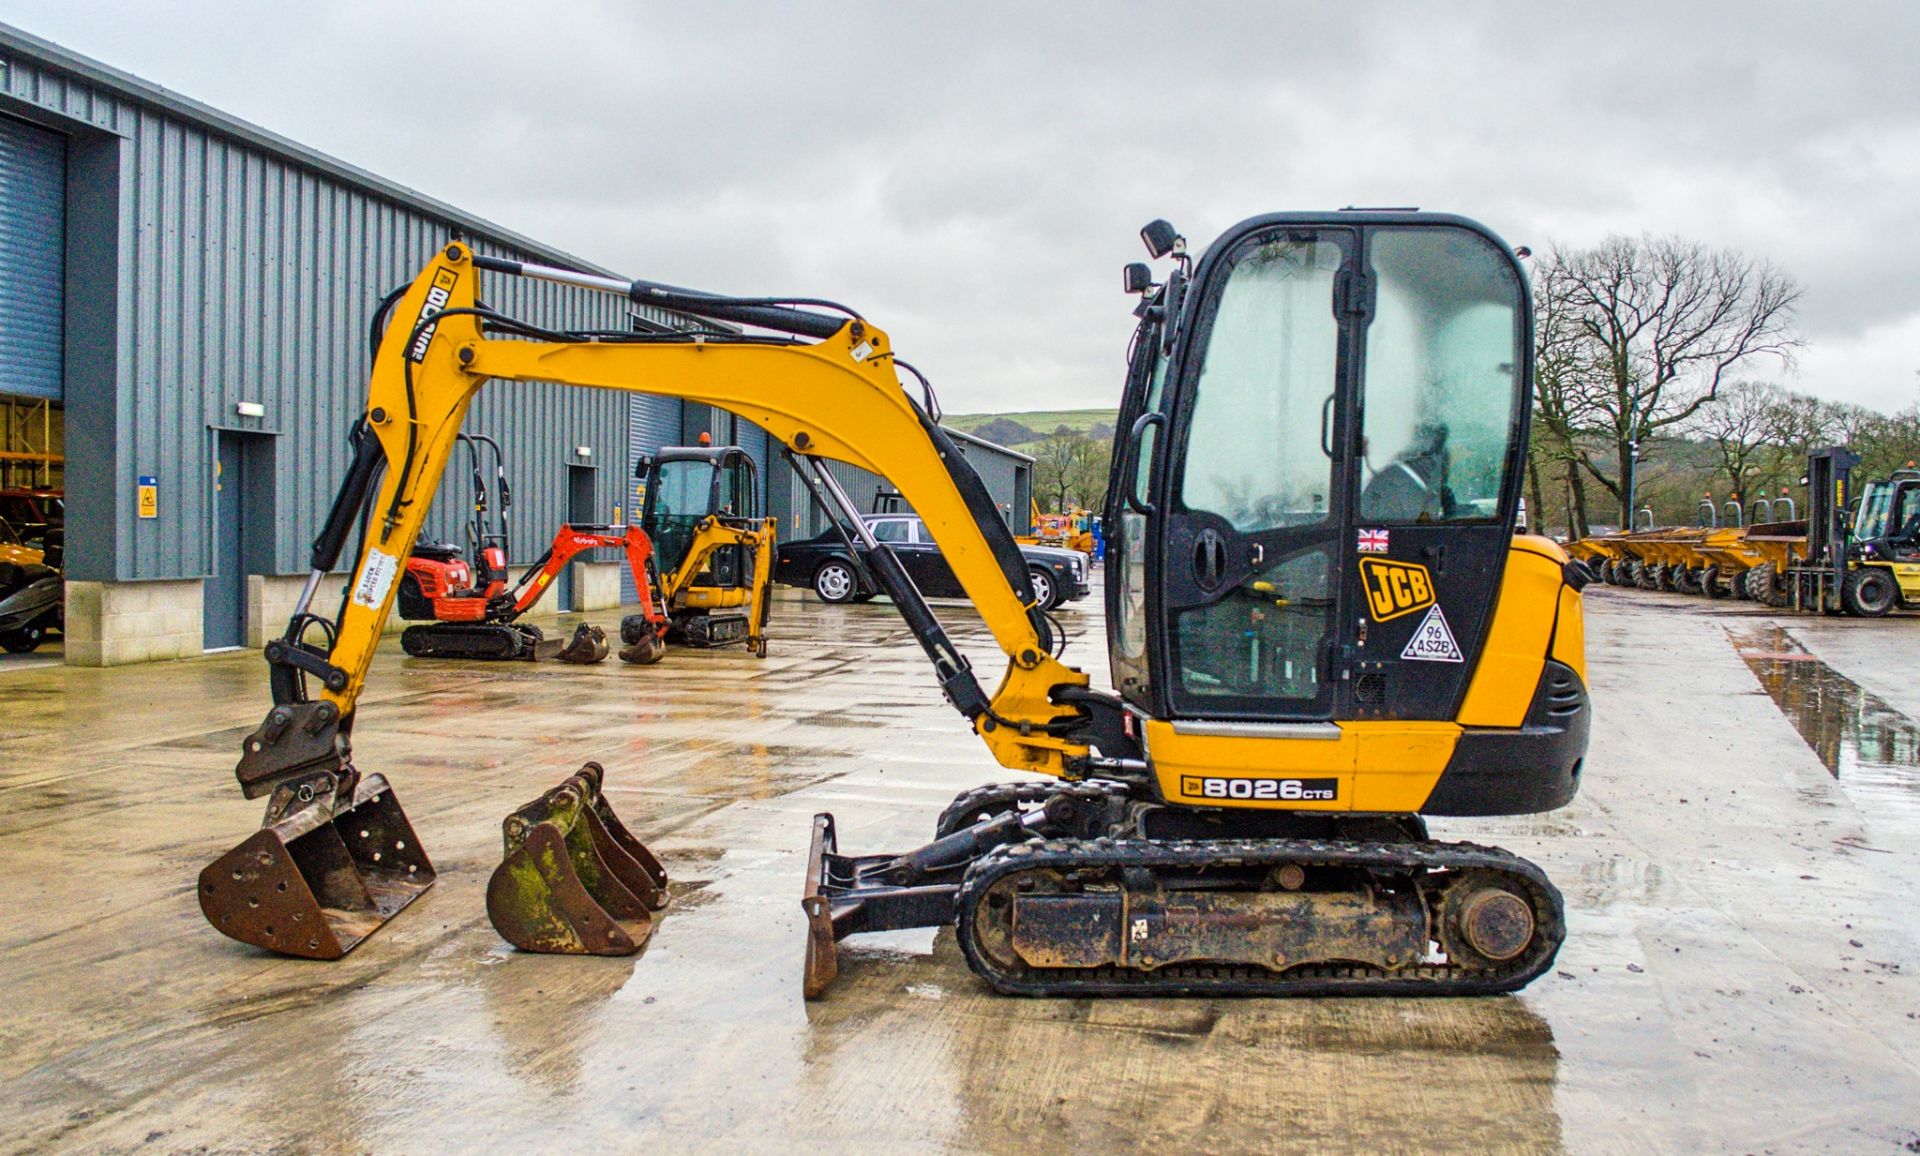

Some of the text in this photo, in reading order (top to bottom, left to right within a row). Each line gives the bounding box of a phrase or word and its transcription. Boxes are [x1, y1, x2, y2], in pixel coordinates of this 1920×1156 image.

[1371, 564, 1428, 614] JCB
[1427, 626, 1441, 639] 96
[1417, 639, 1450, 653] AS2B
[1204, 778, 1302, 799] 8026
[1303, 789, 1334, 800] CTS
